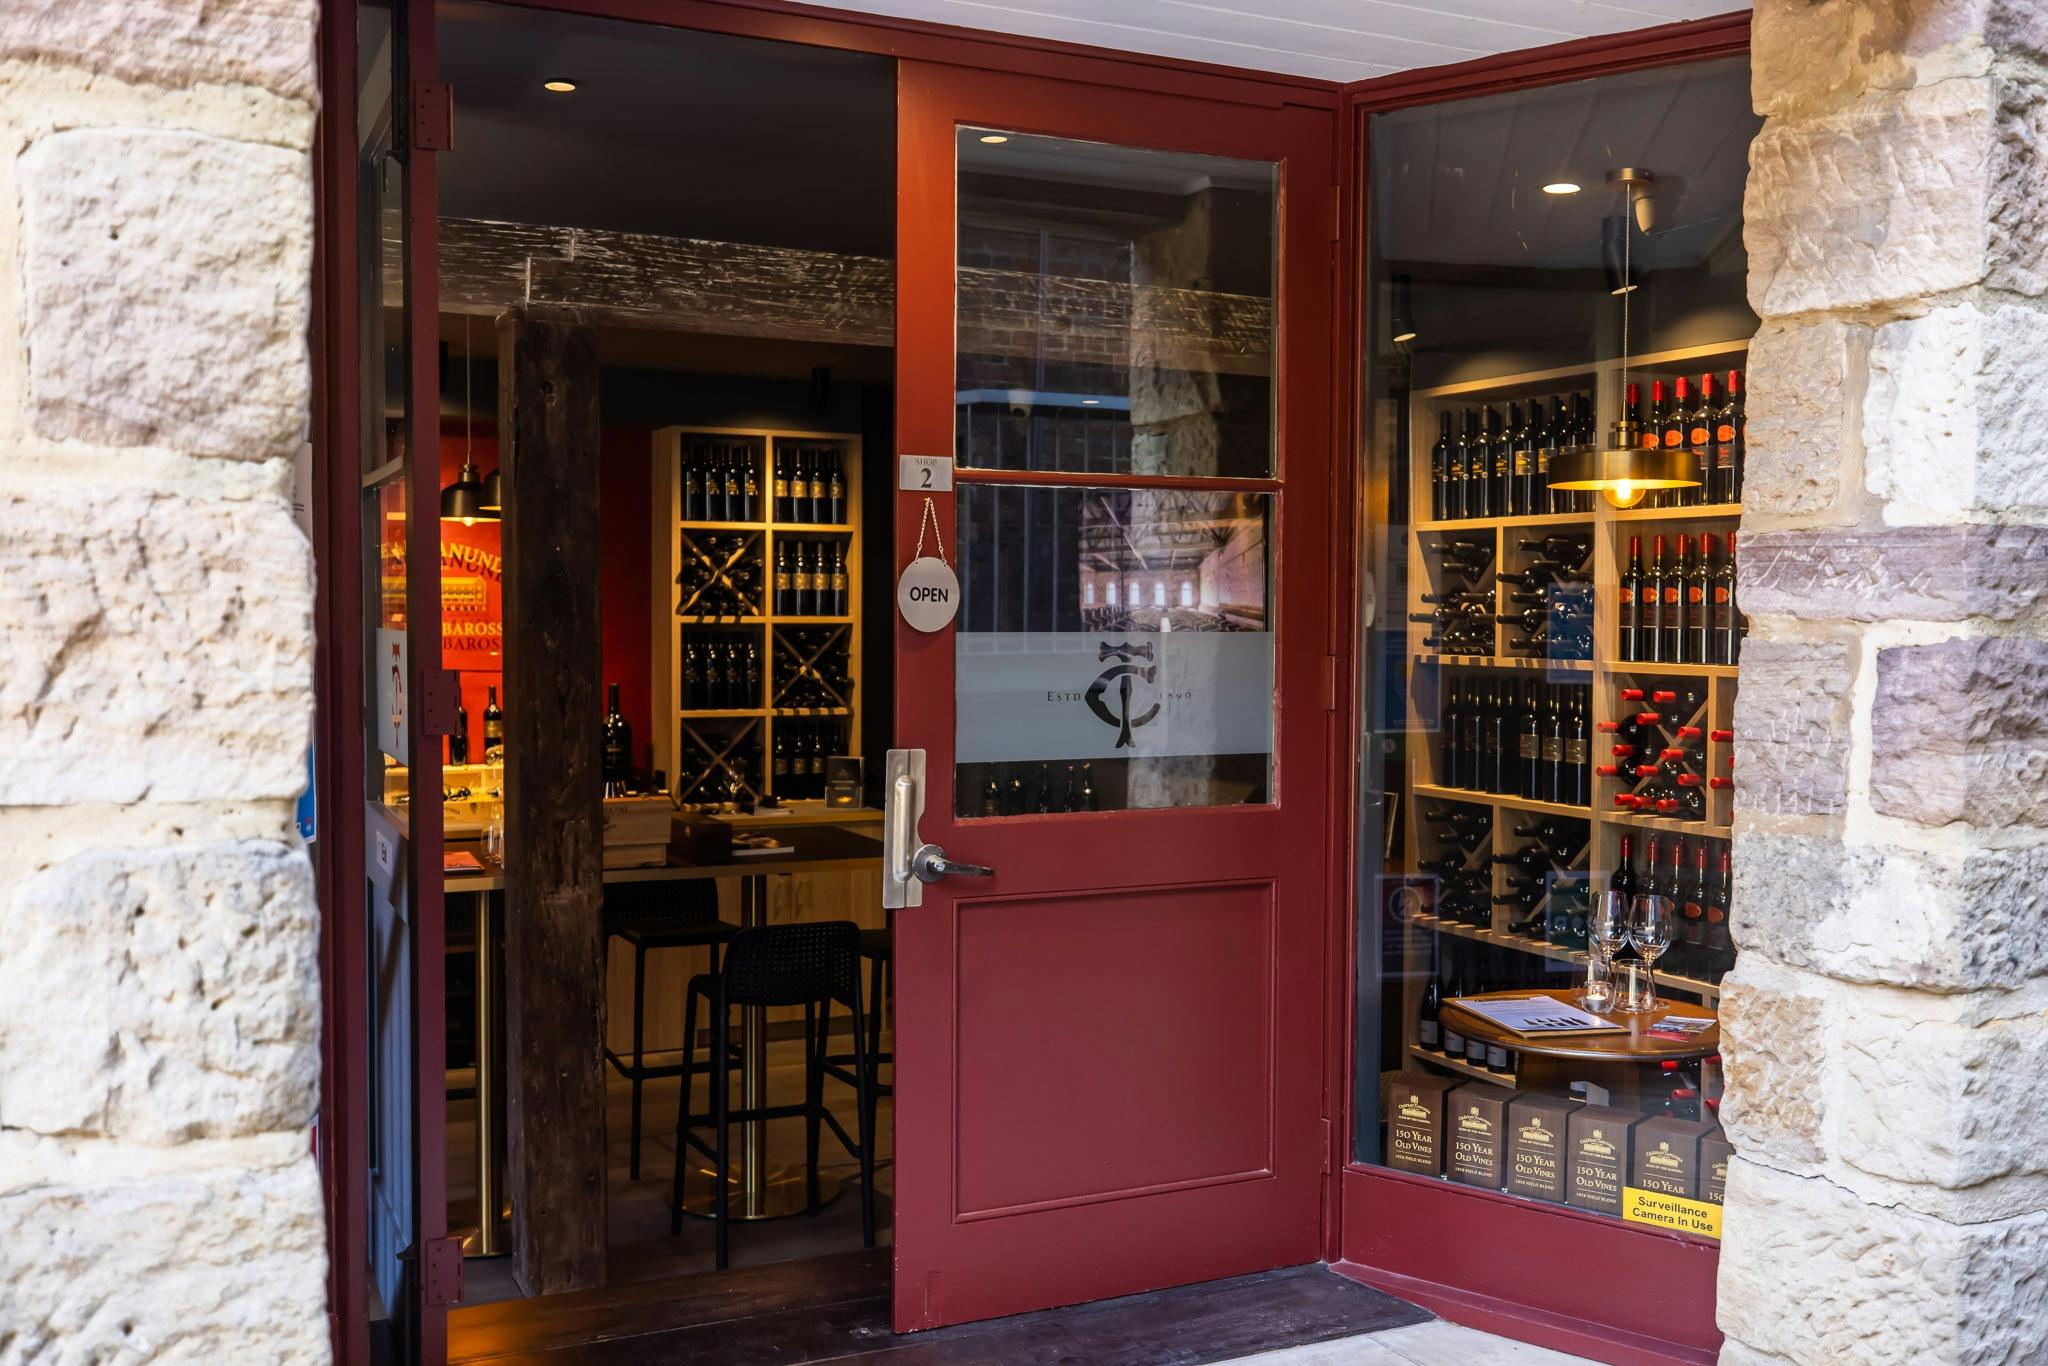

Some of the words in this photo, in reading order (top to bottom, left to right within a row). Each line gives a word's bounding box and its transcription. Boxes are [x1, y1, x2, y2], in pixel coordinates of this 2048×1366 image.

[915, 458, 937, 466] SHOP
[920, 468, 932, 488] 2
[910, 586, 948, 602] OPEN
[1396, 1130, 1410, 1138] 150
[1411, 1131, 1432, 1142] YEAR
[1395, 1140, 1411, 1149] OLD
[1412, 1142, 1432, 1153] VINES
[1456, 1142, 1470, 1151] 150
[1472, 1143, 1493, 1155] YEAR
[1455, 1152, 1471, 1161] OLD
[1472, 1155, 1493, 1166] VINES
[1516, 1154, 1531, 1162] 150
[1533, 1155, 1555, 1167] YEAR
[1516, 1164, 1532, 1174] OLD
[1533, 1167, 1555, 1178] VINES
[1576, 1167, 1593, 1176] 150
[1594, 1167, 1617, 1181] YEAR
[1576, 1177, 1593, 1187] OLD
[1595, 1180, 1617, 1192] VINES
[1643, 1180, 1659, 1188] 150
[1661, 1180, 1685, 1194] YEAR
[1638, 1196, 1707, 1218] Surveillance
[1632, 1207, 1674, 1224] Camera
[1678, 1216, 1688, 1226] In
[1692, 1218, 1713, 1232] Use
